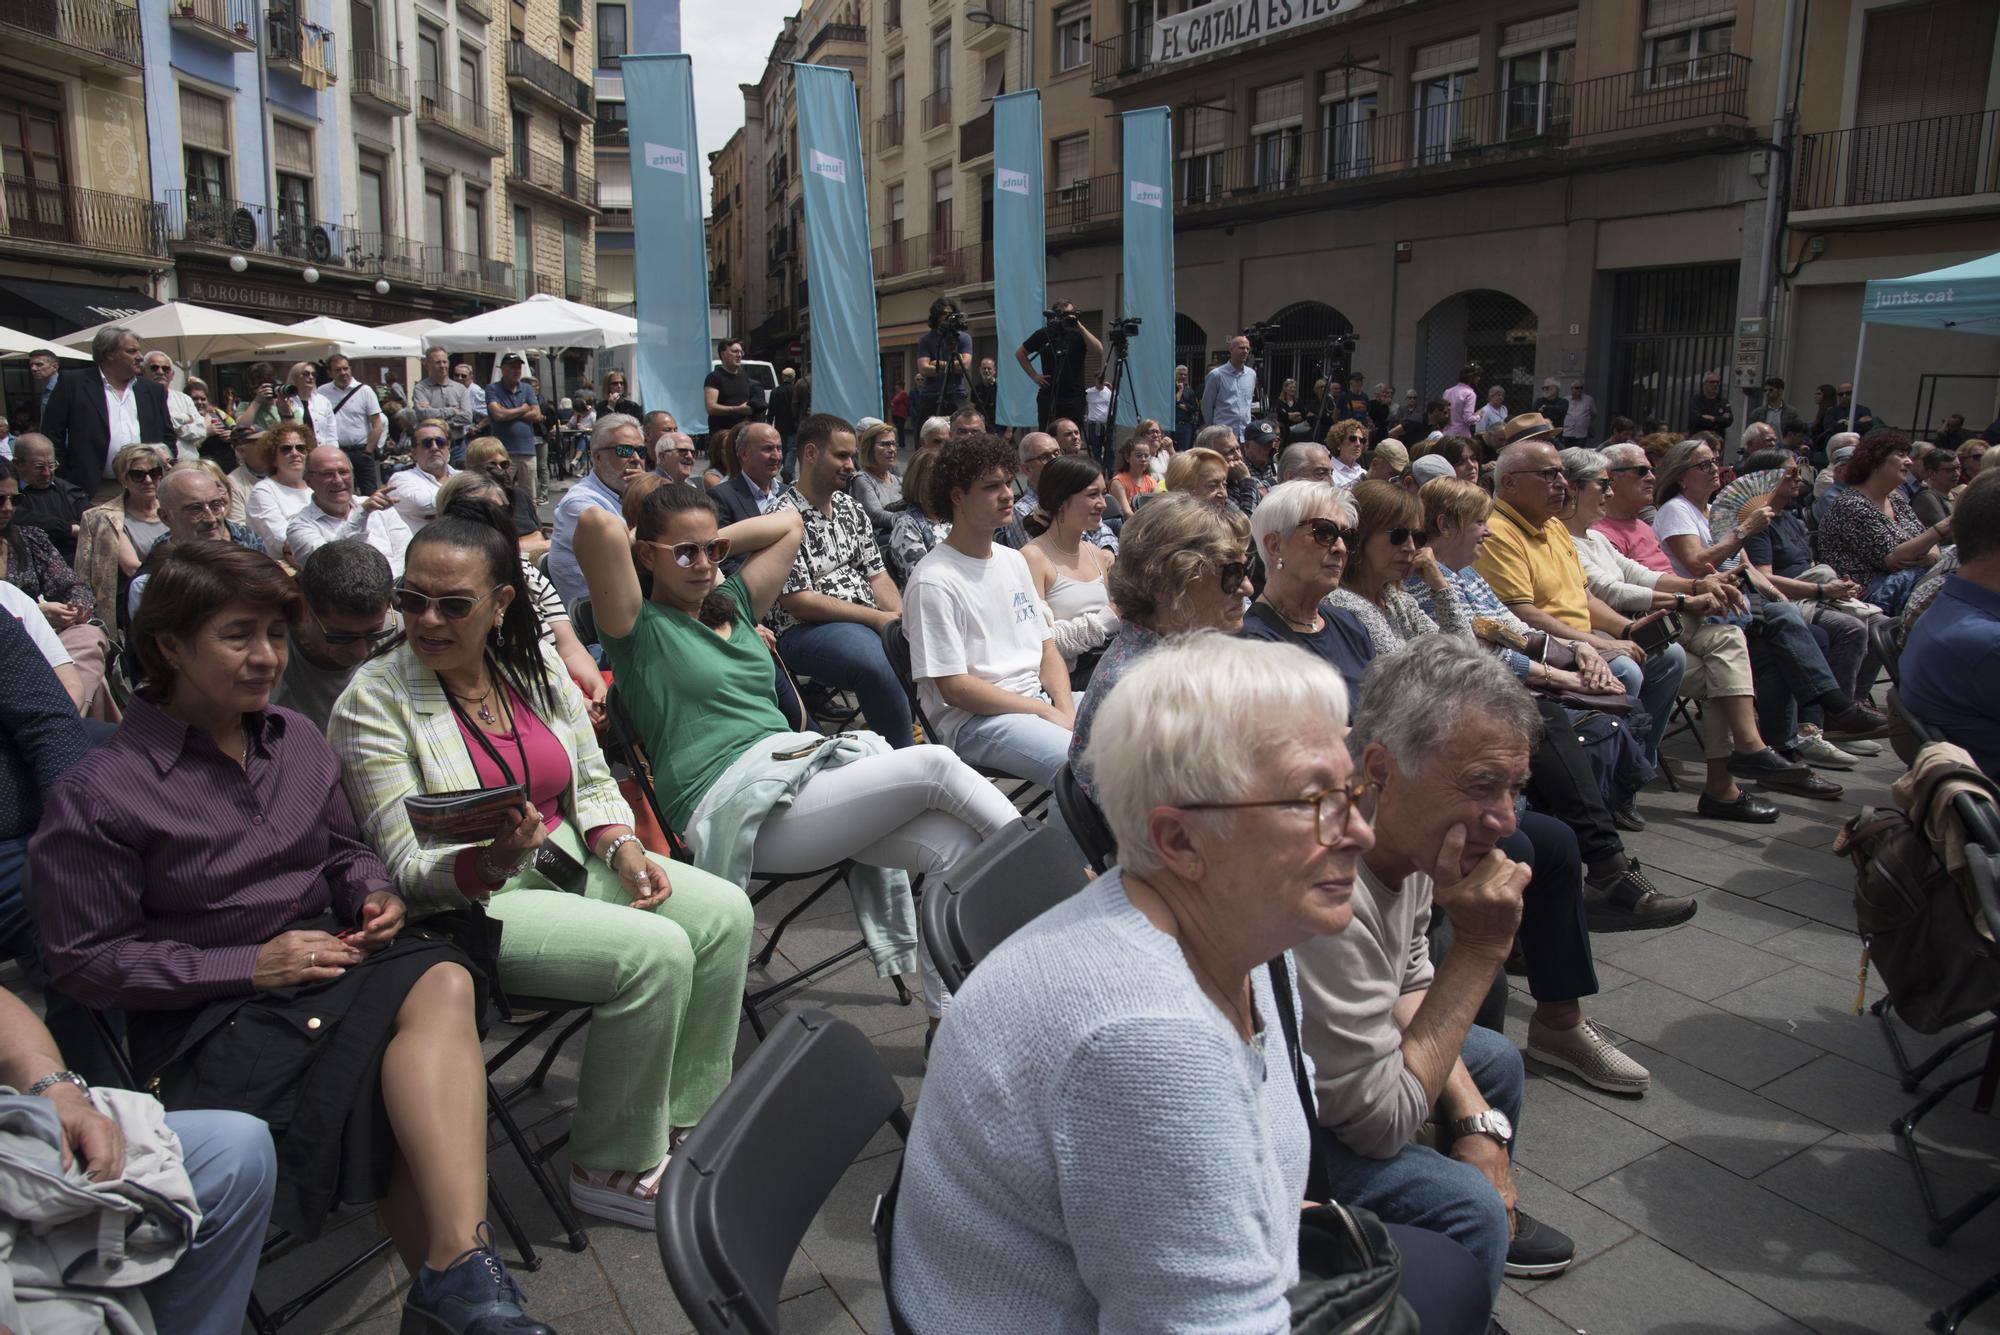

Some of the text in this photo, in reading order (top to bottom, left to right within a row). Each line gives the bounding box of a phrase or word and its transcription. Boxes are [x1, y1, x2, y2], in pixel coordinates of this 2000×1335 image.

[1160, 25, 1183, 61] EL
[208, 284, 290, 308] DROGUERIA
[297, 296, 342, 315] FERRER
[1874, 288, 1955, 309] junts.cat
